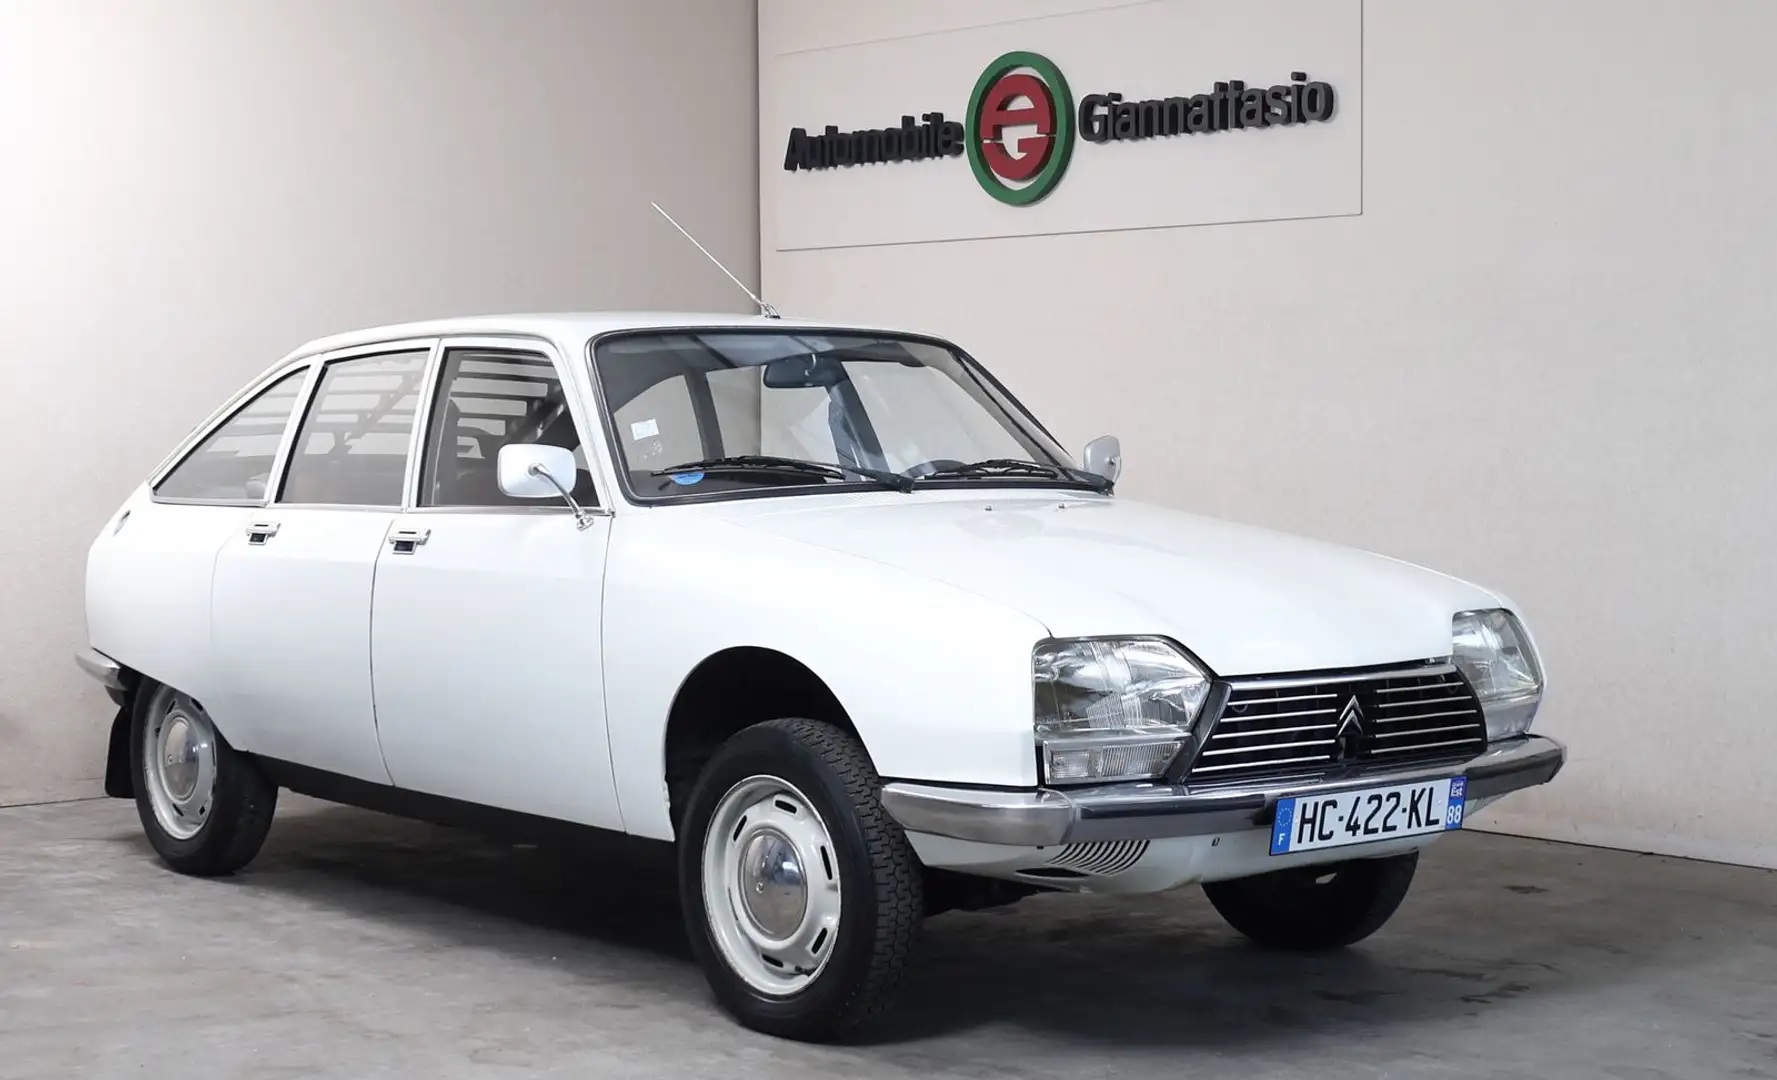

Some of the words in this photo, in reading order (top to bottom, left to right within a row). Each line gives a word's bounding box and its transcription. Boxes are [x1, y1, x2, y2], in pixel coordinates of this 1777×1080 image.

[784, 112, 965, 172] Automobile
[1078, 71, 1335, 142] Giannattasio
[1447, 804, 1462, 824] 88
[1278, 833, 1286, 846] F
